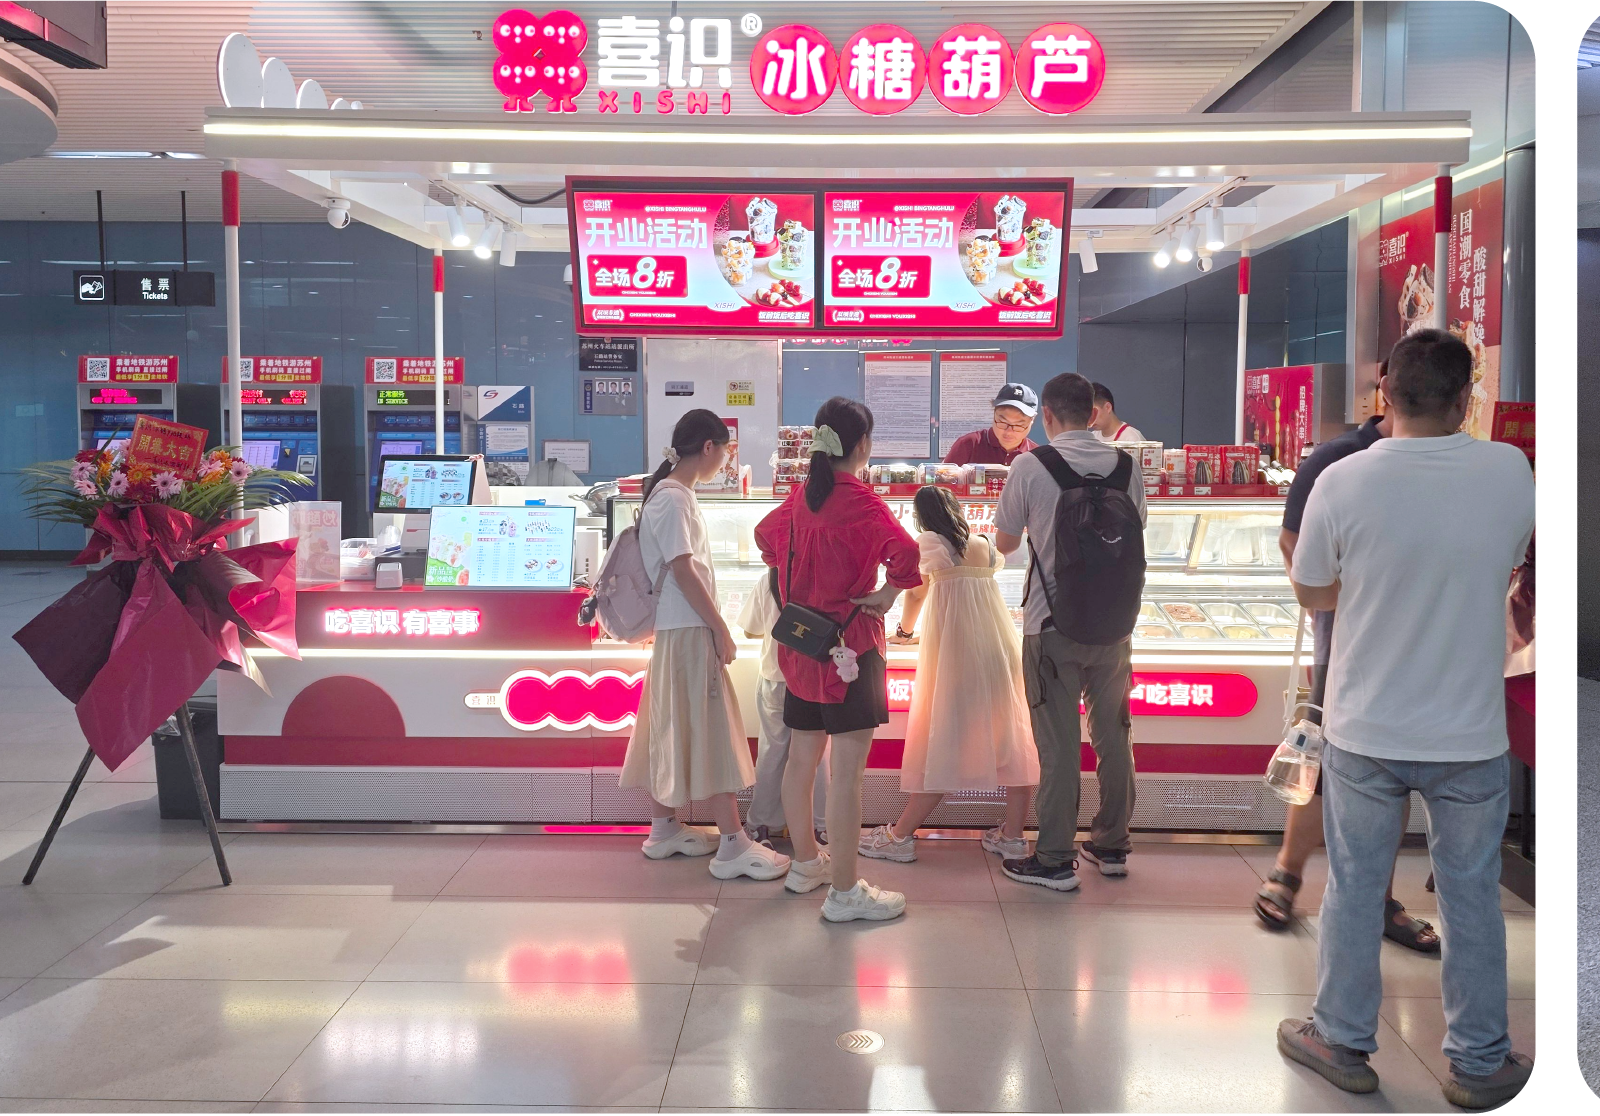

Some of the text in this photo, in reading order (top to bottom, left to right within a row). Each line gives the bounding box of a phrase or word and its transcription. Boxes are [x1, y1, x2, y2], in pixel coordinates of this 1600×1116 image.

[763, 34, 1092, 101] 冰糖葫芦
[599, 91, 732, 115] XISHI
[585, 217, 708, 249] 开业活动
[832, 217, 954, 249] 开业活动
[594, 256, 675, 289] 全场8折
[837, 256, 919, 289] 全场8折
[1458, 208, 1473, 310] 国潮零食
[141, 277, 170, 291] 售票
[142, 292, 168, 300] Tickets
[379, 390, 405, 398] 正常服务
[324, 608, 480, 635] 吃喜识 有喜事
